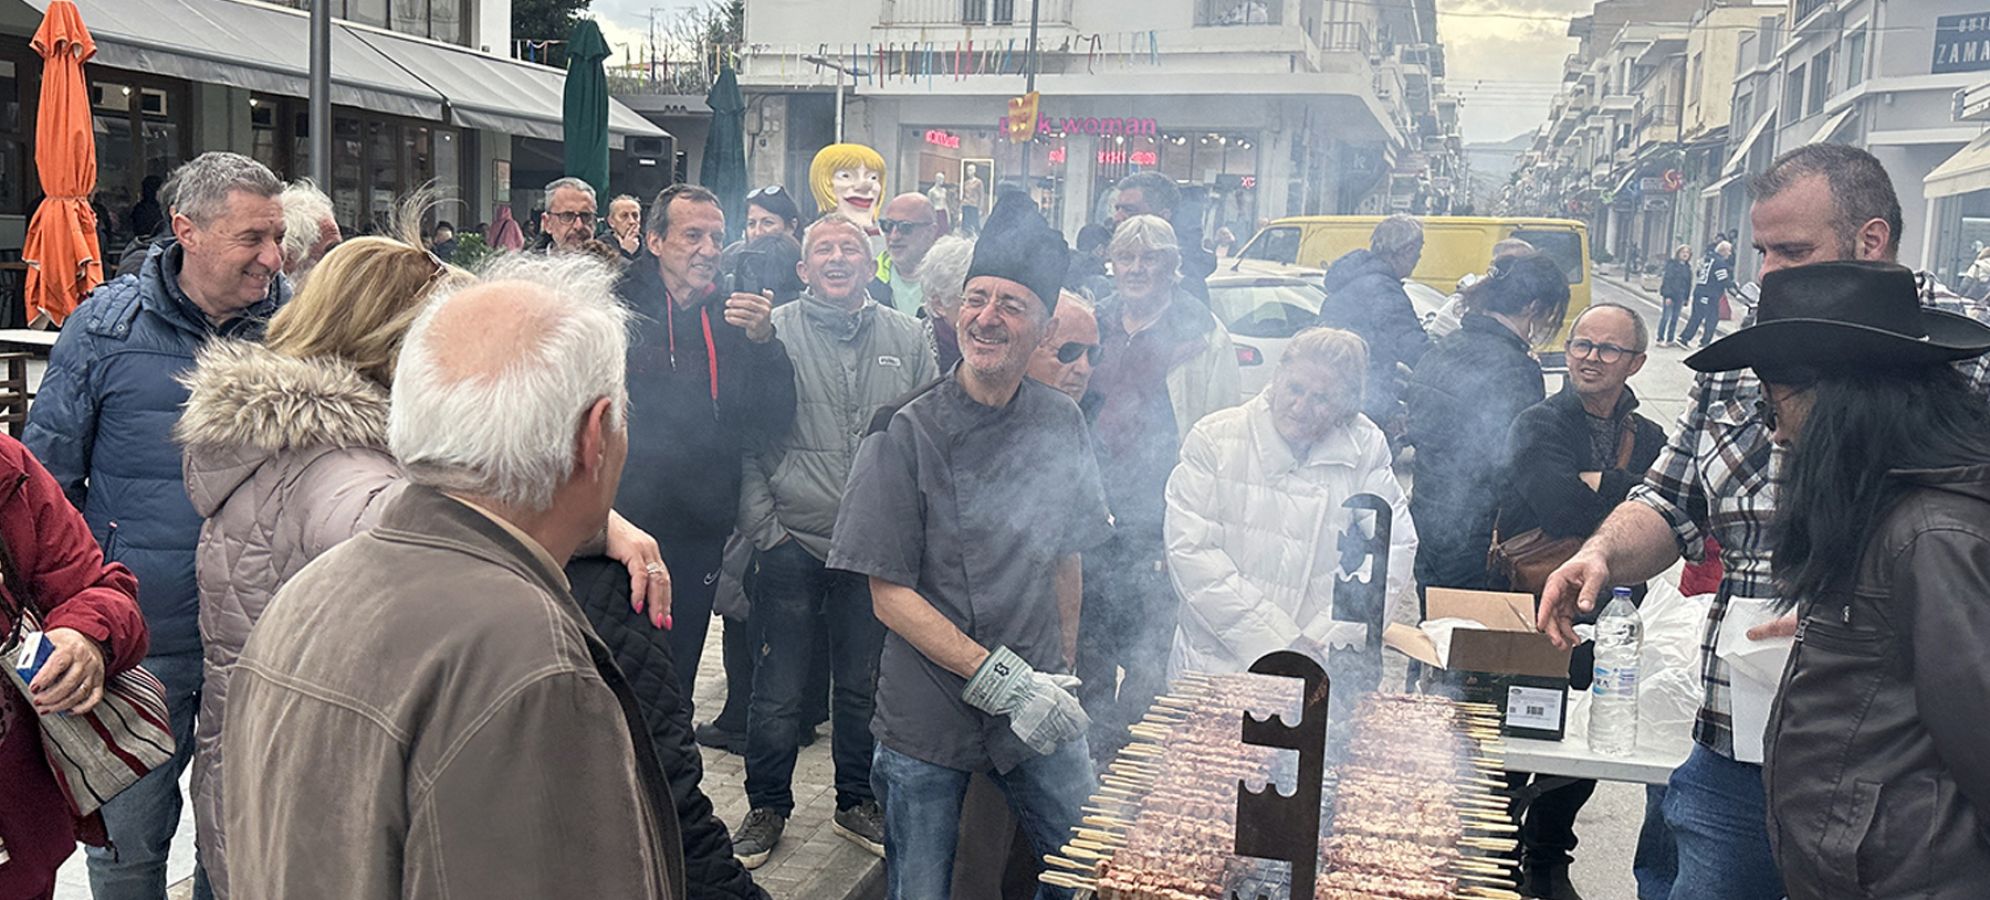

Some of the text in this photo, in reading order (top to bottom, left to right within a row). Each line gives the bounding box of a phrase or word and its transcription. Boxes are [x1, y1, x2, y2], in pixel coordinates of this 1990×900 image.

[1959, 16, 1990, 32] OUT
[999, 112, 1157, 136] pk woman
